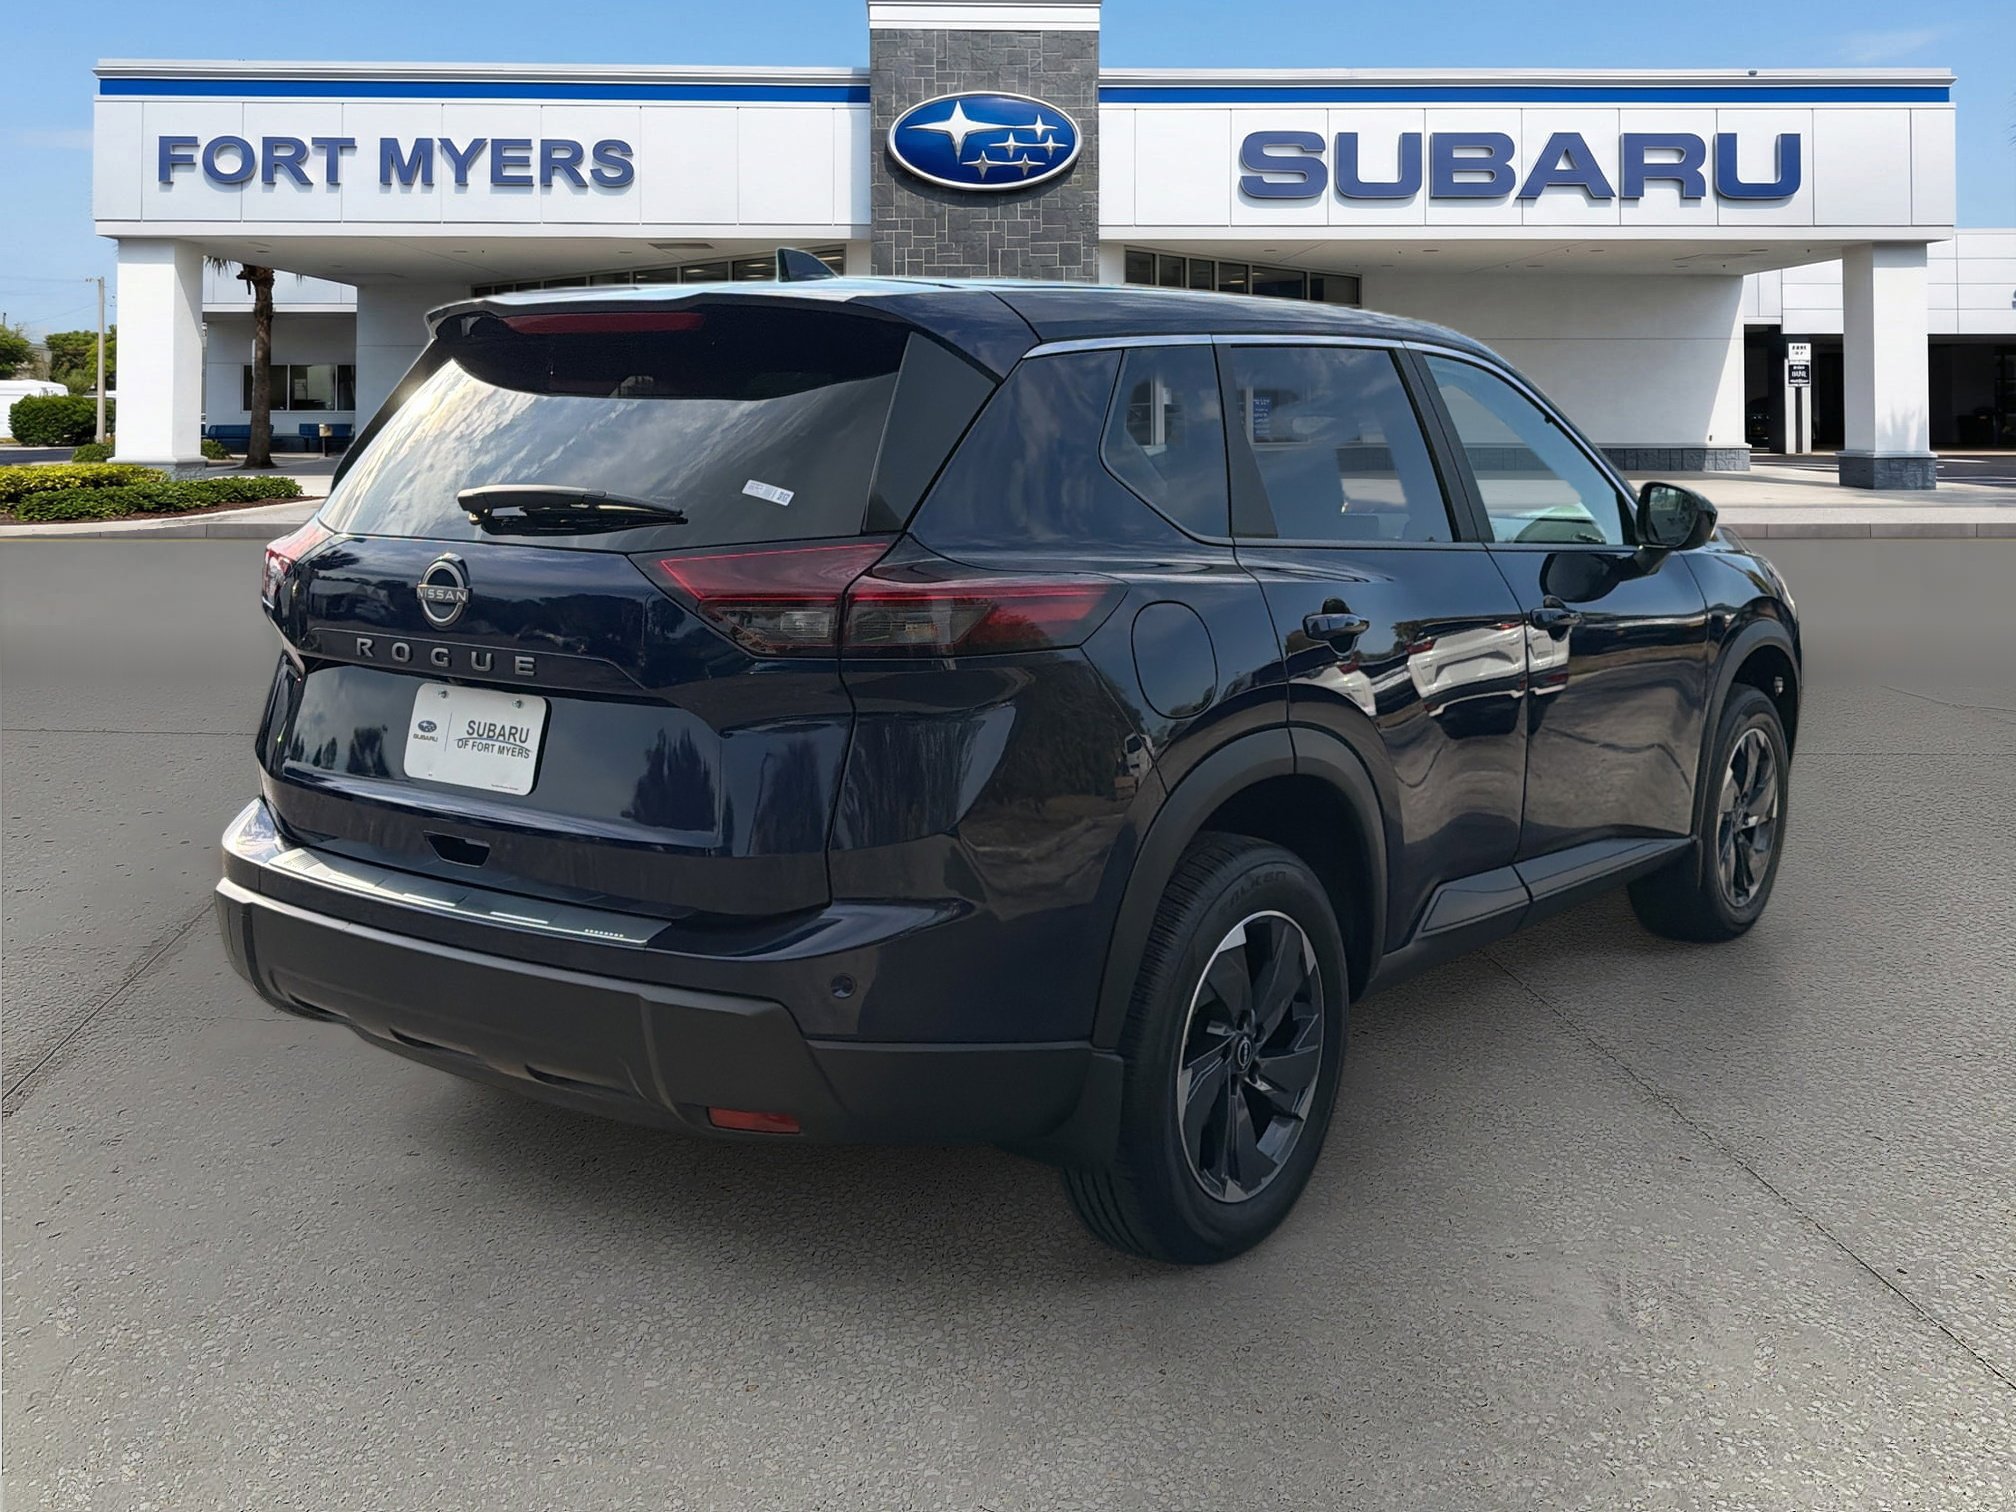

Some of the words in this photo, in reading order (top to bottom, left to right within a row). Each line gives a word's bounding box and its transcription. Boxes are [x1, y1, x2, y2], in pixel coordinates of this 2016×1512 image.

[158, 135, 358, 186] FORT
[379, 137, 635, 188] MYERS
[1240, 130, 1802, 200] SUBARU
[417, 587, 467, 602] NISSAN
[356, 637, 536, 676] ROGUE
[413, 732, 438, 743] SUBARU
[466, 719, 530, 744] SUBARU
[456, 738, 470, 750] OF
[471, 740, 497, 755] FORT
[497, 745, 530, 759] MYERS
